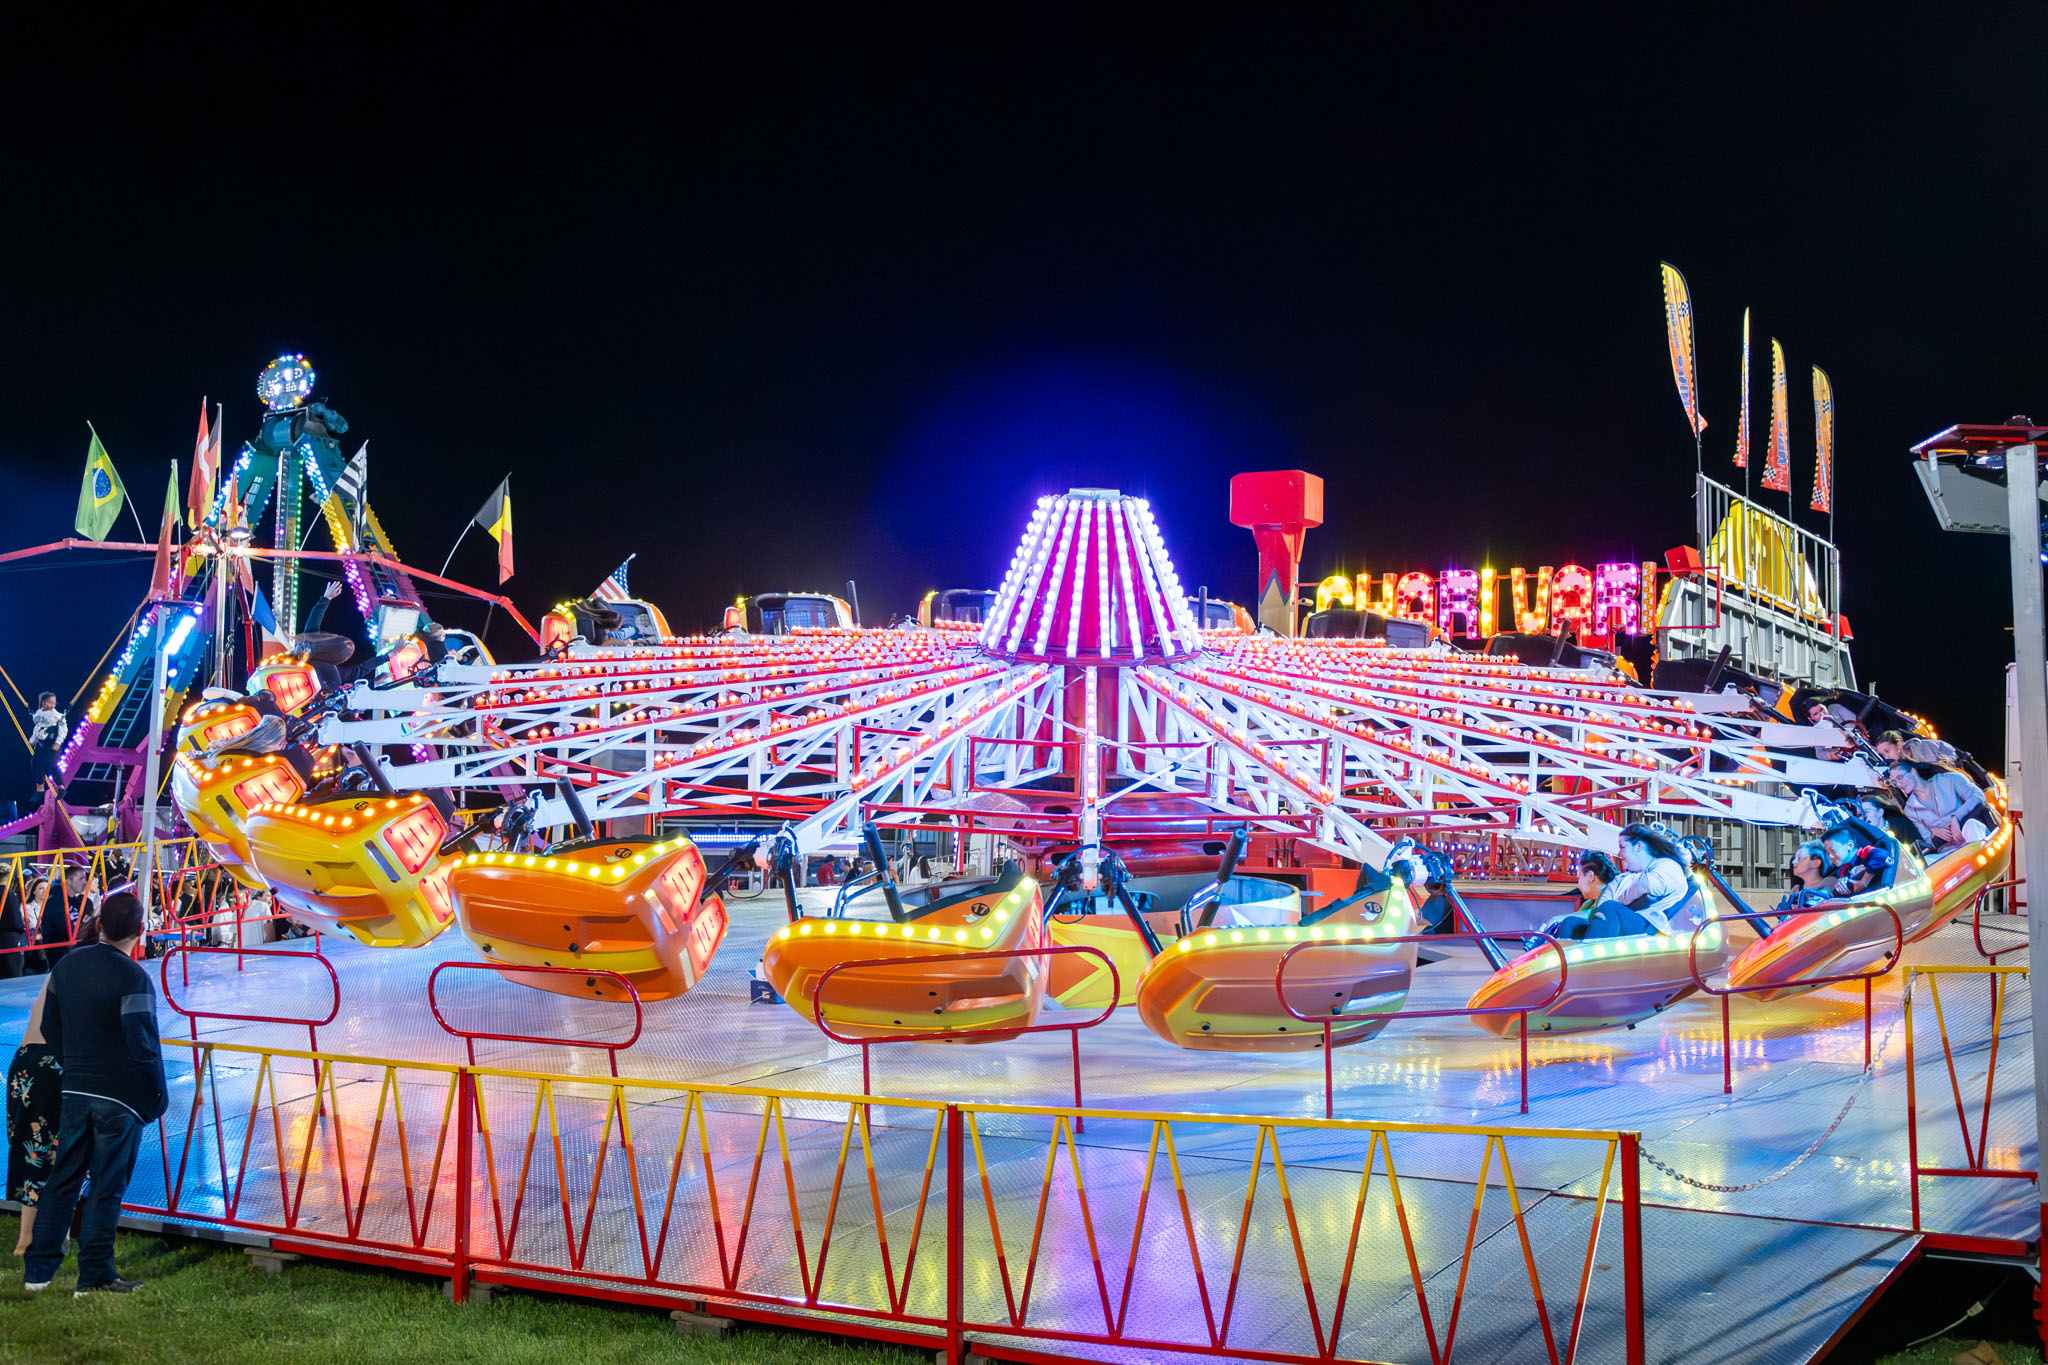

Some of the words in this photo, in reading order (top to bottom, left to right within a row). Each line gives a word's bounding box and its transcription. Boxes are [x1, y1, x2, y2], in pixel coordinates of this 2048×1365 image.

[616, 848, 632, 858] 16
[972, 903, 989, 915] 17
[1365, 902, 1382, 913] 18
